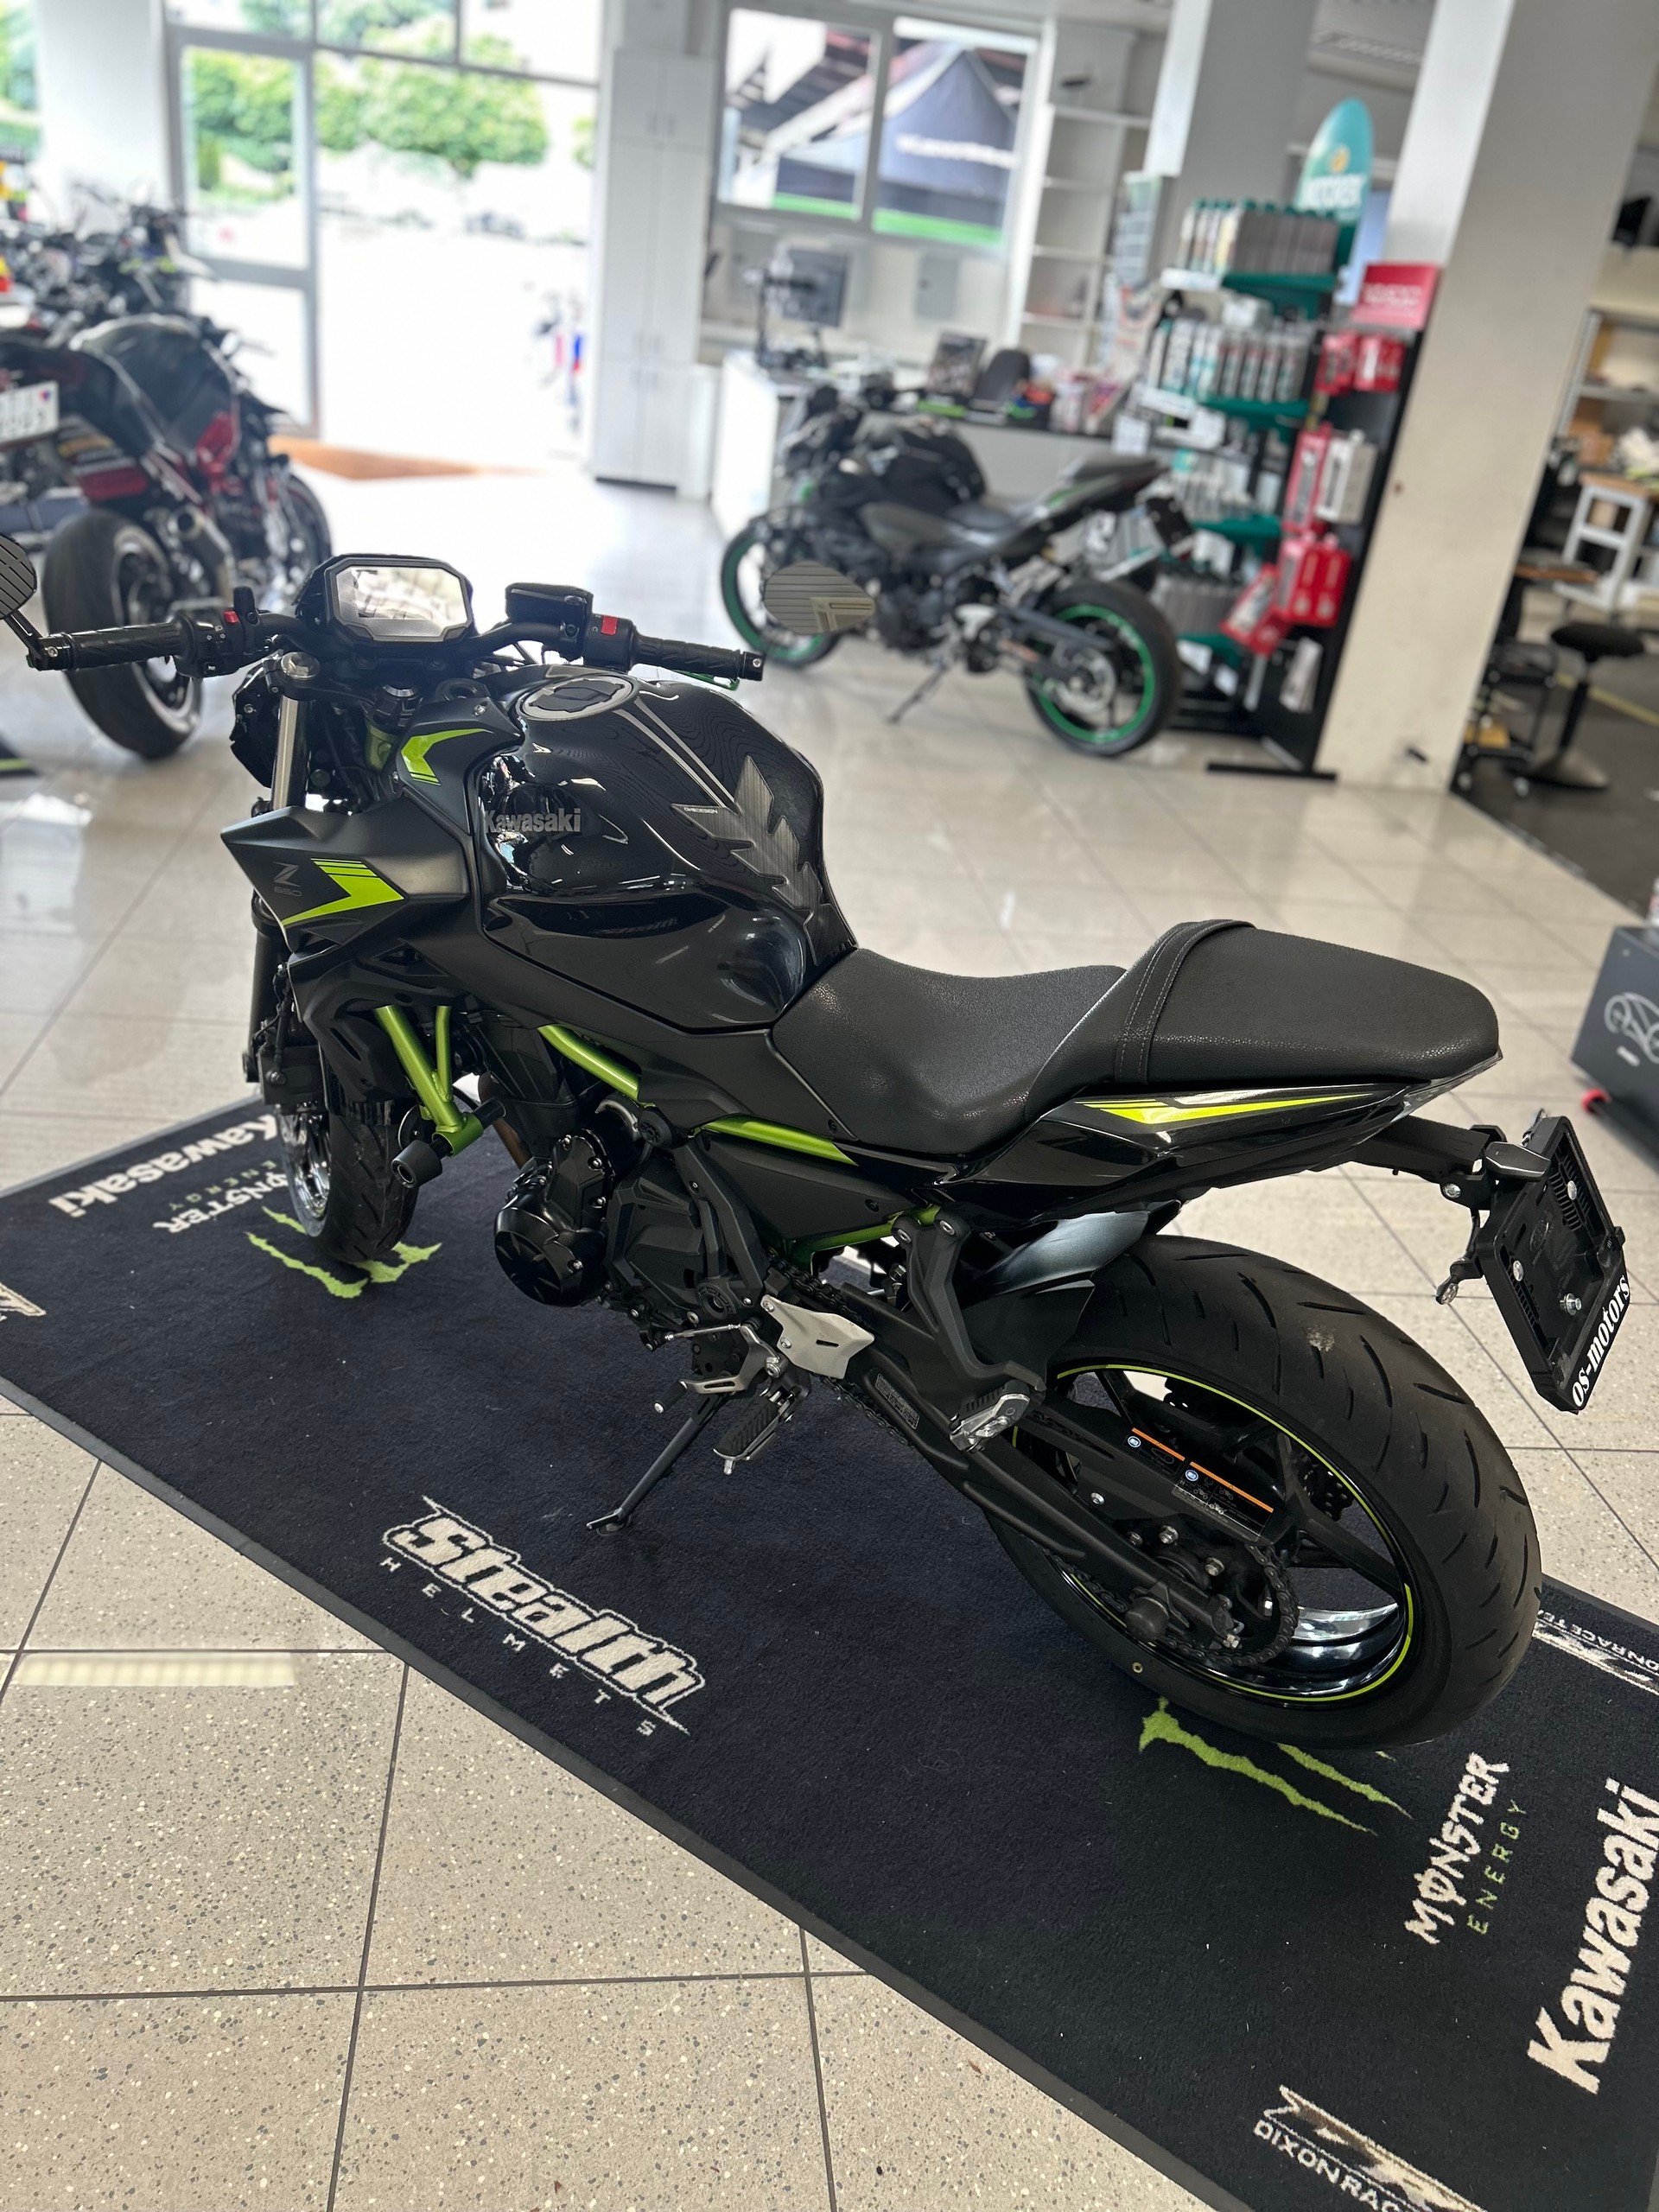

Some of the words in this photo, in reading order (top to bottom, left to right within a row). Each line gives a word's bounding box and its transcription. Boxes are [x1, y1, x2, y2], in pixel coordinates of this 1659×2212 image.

[485, 808, 582, 832] Kawasaki
[274, 887, 302, 897] 650
[48, 1114, 277, 1217] Kawasaki
[153, 1172, 289, 1233] ONSTER
[169, 1160, 276, 1211] ENERGY
[1572, 1274, 1630, 1407] os-motors
[379, 1556, 657, 1737] HELMETS
[384, 1503, 704, 1726] Stealth
[1404, 1752, 1510, 1944] MONSTER
[1466, 1799, 1527, 1935] ENERGY
[1527, 1777, 1659, 2095] Kawasaki
